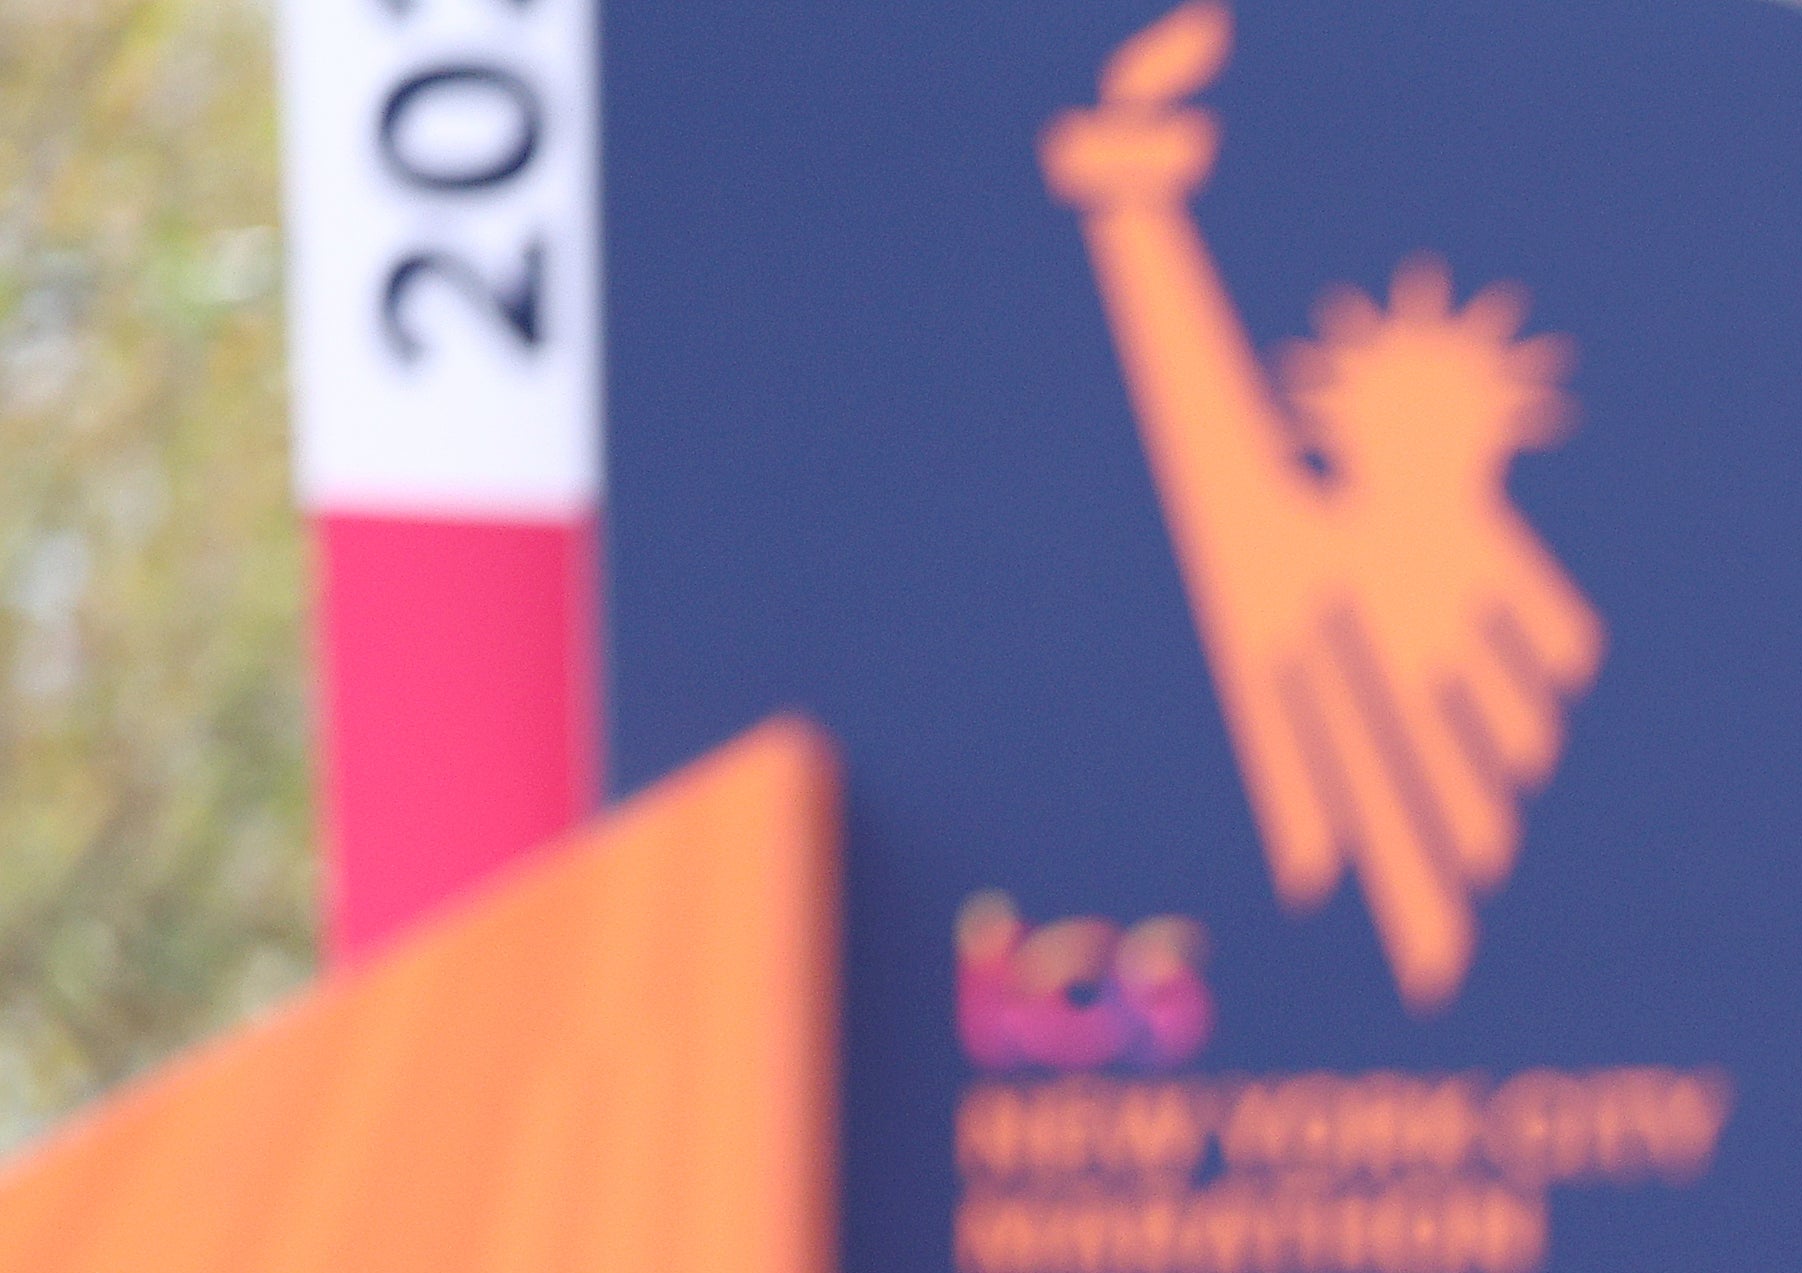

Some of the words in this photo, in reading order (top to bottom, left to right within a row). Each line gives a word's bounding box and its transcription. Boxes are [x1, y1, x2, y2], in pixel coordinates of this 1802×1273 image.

[380, 0, 545, 364] 20
[962, 1080, 1203, 1180] NEW
[1216, 1078, 1488, 1178] YORK
[1490, 1074, 1728, 1180] CITY
